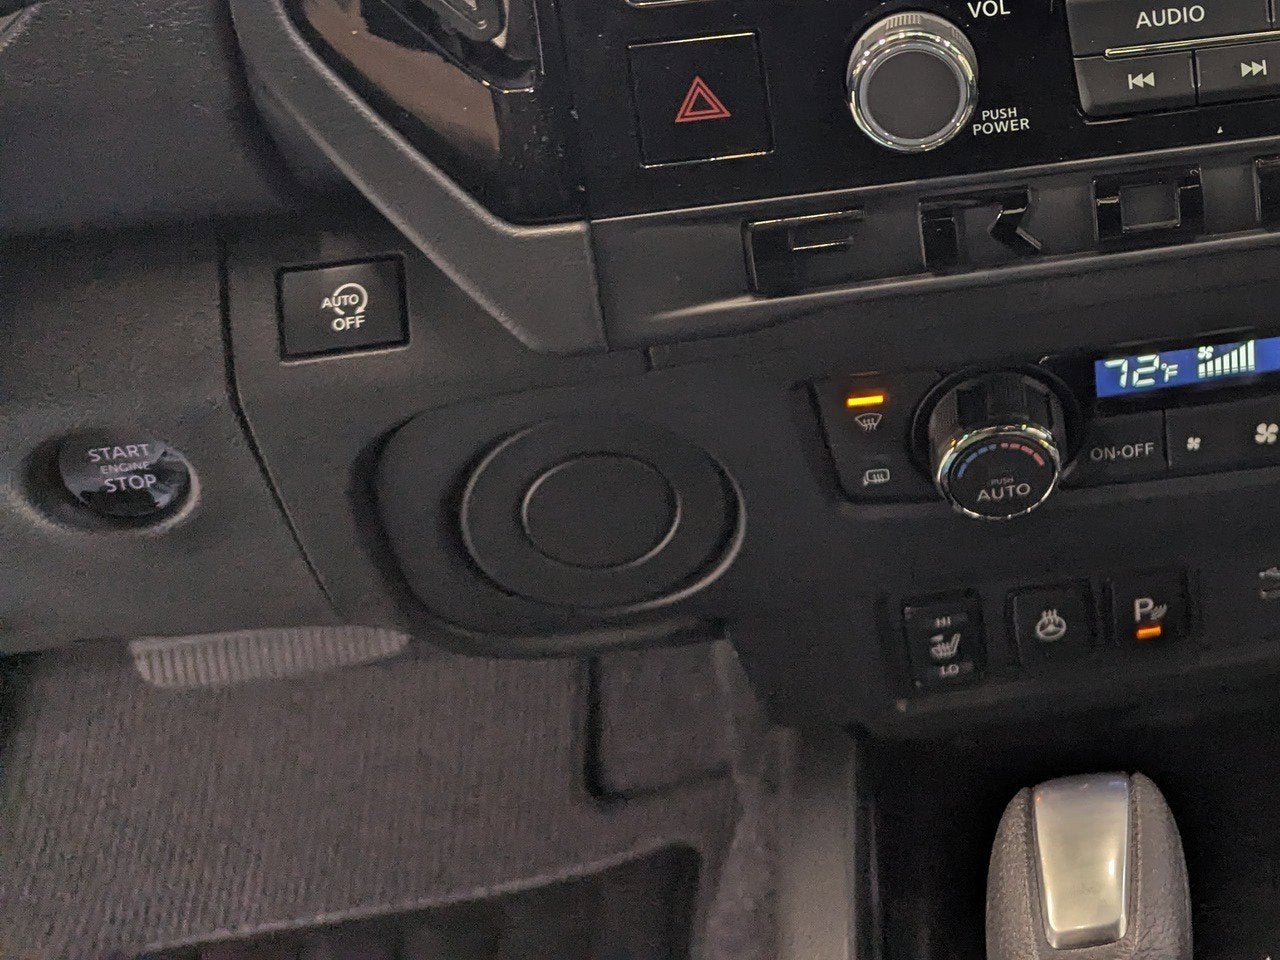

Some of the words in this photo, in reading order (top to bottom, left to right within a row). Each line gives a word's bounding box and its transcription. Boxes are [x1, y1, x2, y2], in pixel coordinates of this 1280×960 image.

[967, 0, 1011, 19] VOL
[1136, 6, 1205, 29] AUDIO
[982, 107, 1018, 121] PUSH
[972, 117, 1030, 136] POWER
[321, 294, 359, 309] AUTO
[331, 315, 365, 331] OFF
[88, 443, 149, 462] START
[104, 474, 157, 493] STOP
[977, 483, 1030, 502] AUTO
